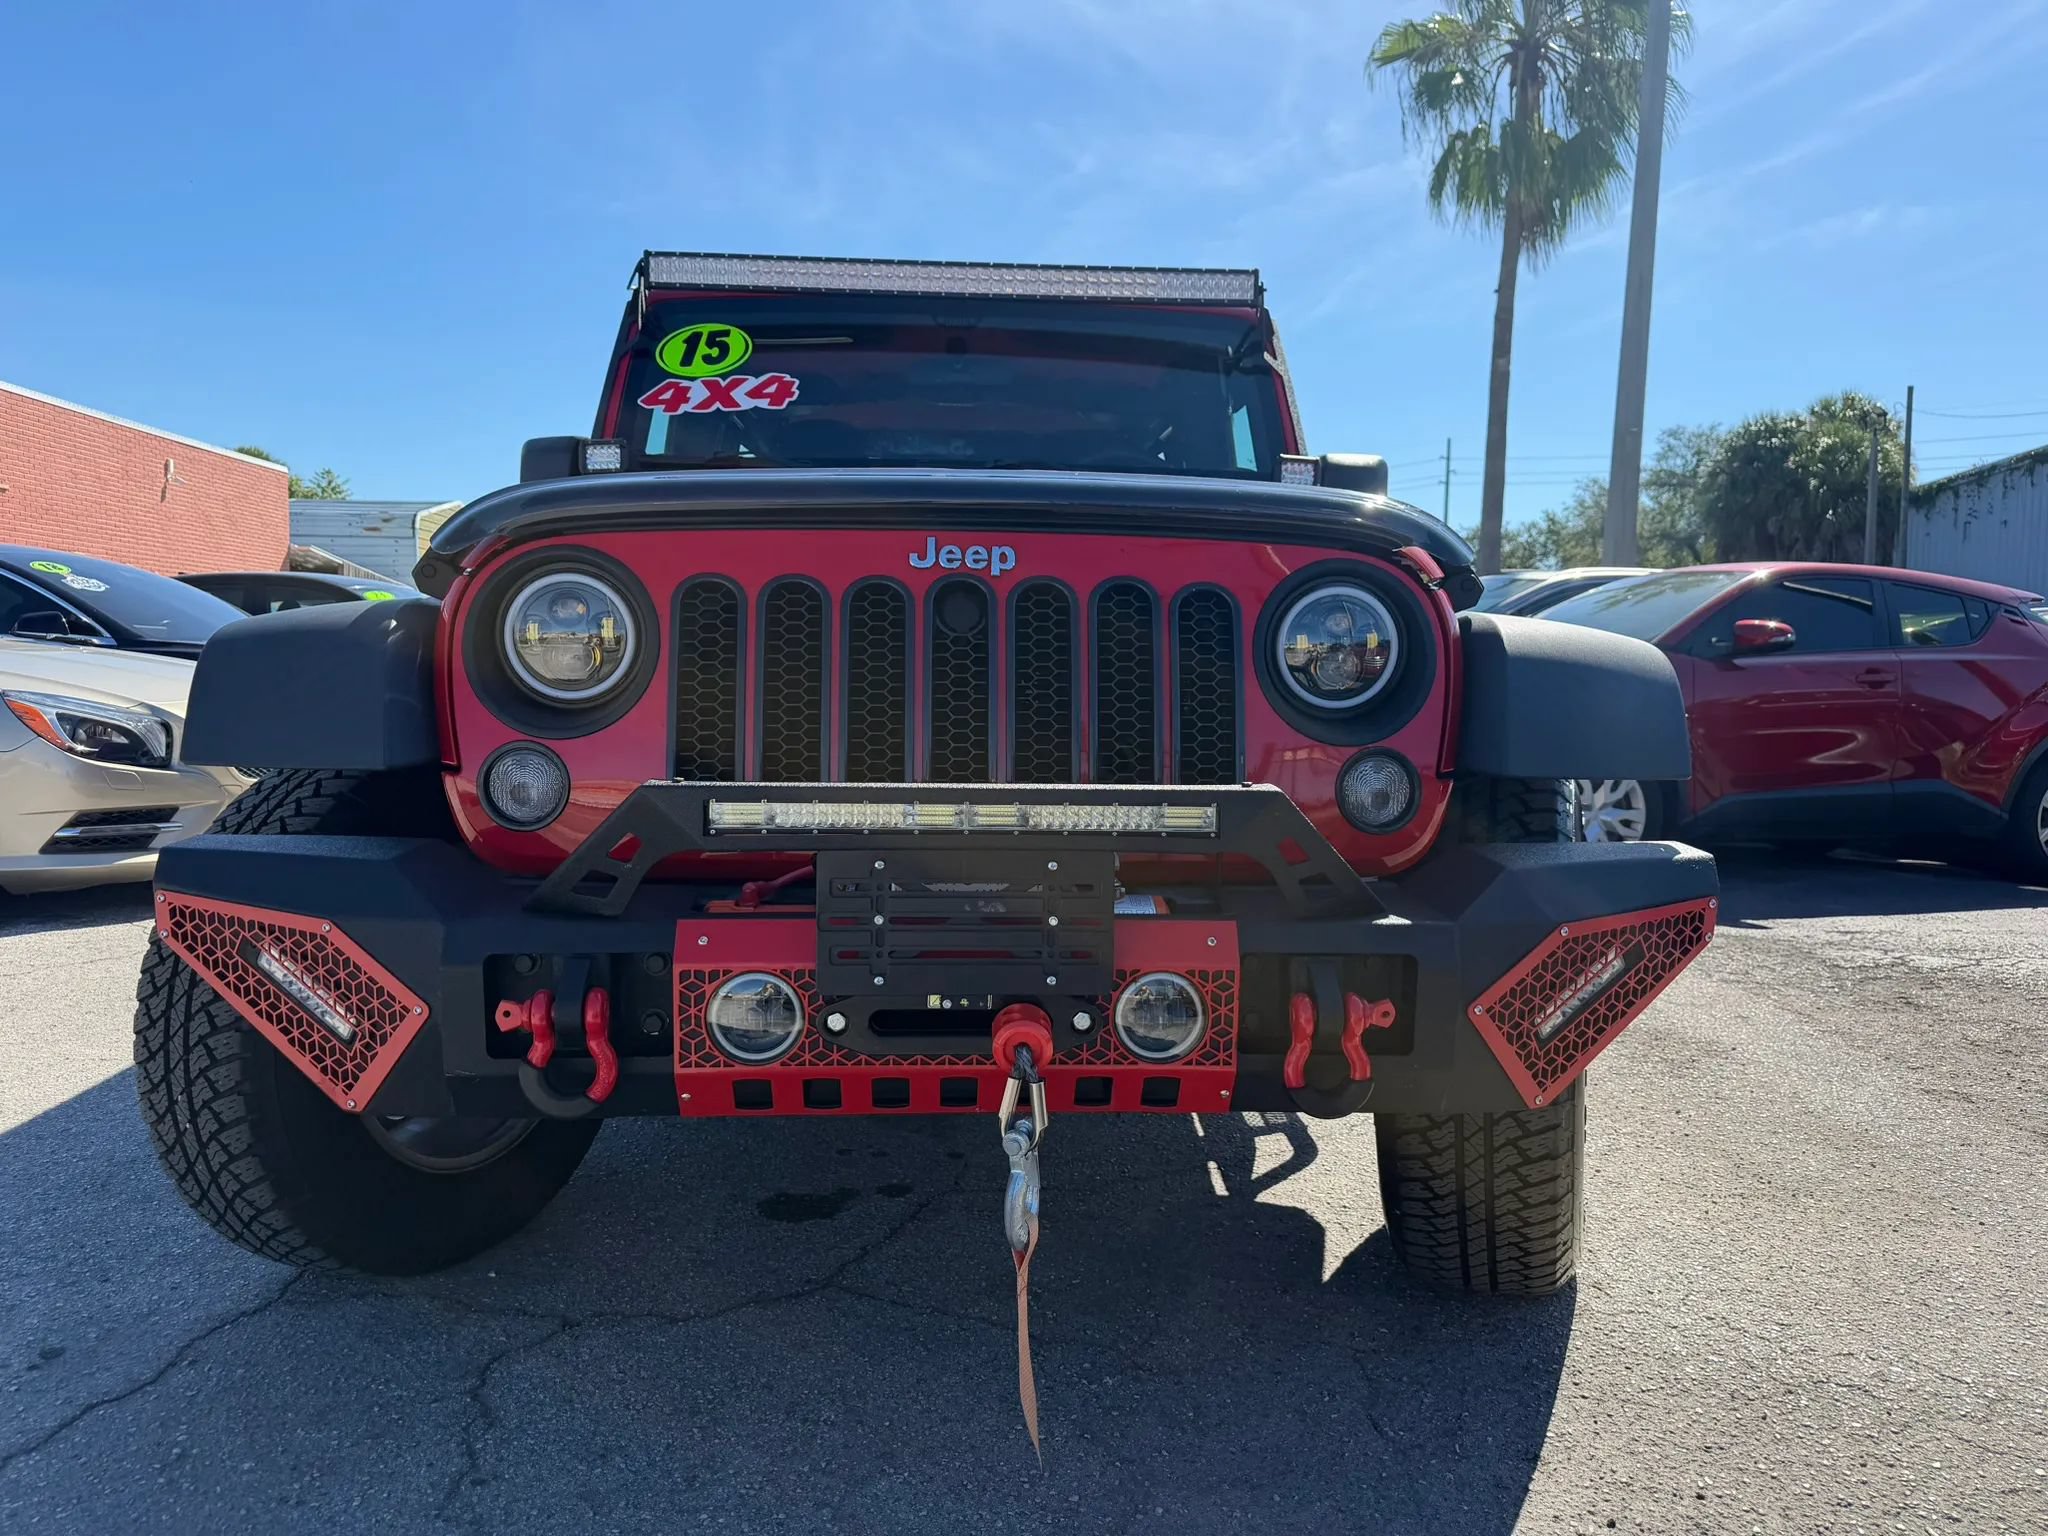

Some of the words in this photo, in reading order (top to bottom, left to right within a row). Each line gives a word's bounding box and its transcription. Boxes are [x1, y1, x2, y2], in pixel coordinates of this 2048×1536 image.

[679, 329, 732, 368] 15
[639, 374, 798, 414] 4X4
[908, 536, 1016, 576] Jeep
